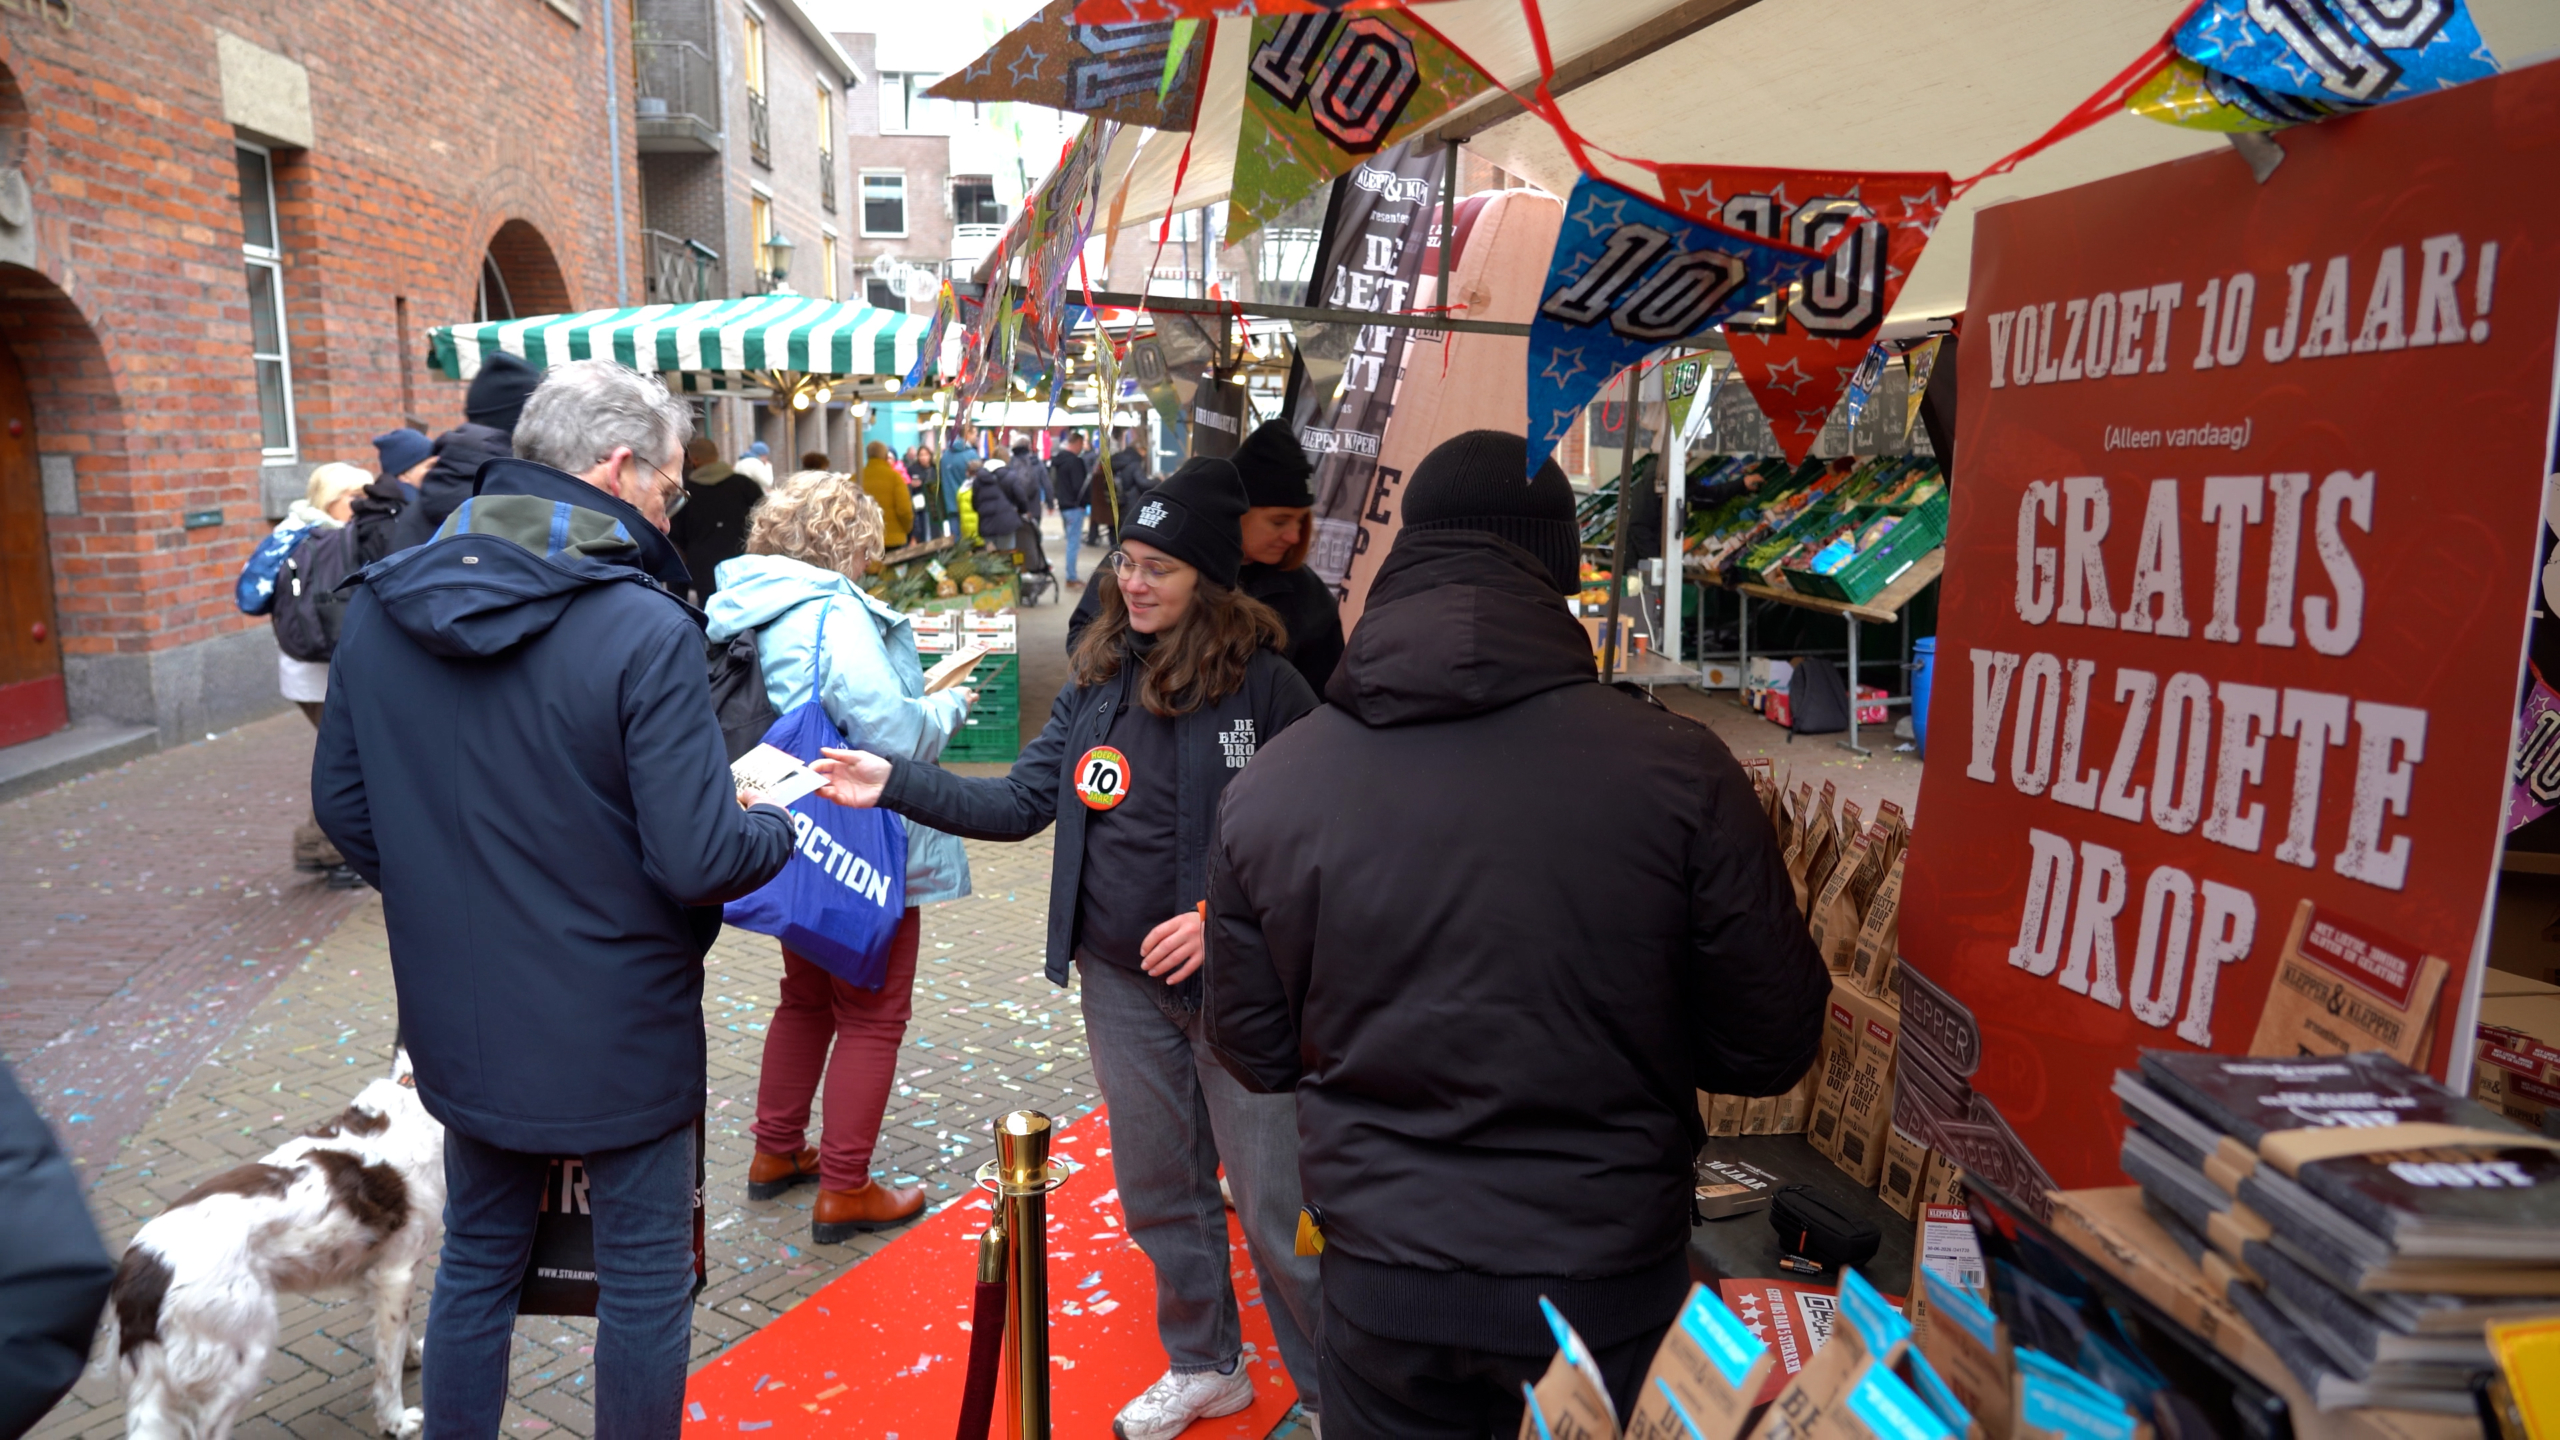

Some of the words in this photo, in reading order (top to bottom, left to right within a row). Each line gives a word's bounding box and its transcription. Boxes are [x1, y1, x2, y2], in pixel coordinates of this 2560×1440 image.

[1250, 12, 1421, 155] 10
[1541, 222, 1747, 344] 10
[1987, 281, 2183, 389] VOLZOET
[2193, 273, 2256, 371] 10
[2262, 234, 2499, 362] JAAR!
[1669, 360, 1700, 400] 10
[2104, 424, 2161, 451] (Alleen
[2165, 418, 2252, 449] vandaag)
[2013, 469, 2376, 657] GRATIS
[1218, 731, 1257, 744] BEST
[1233, 719, 1255, 731] DE
[1091, 750, 1121, 765] HOERA!
[1223, 743, 1255, 756] DRO
[1088, 762, 1118, 794] 10
[1966, 648, 2428, 891] VOLZOETE
[1087, 791, 1115, 806] JAAR!
[794, 811, 892, 909] ACTION
[1873, 894, 1896, 913] BESTE
[1884, 886, 1895, 899] DE
[1866, 917, 1884, 933] OOIT
[1870, 905, 1889, 922] DROP
[2008, 827, 2257, 1049] DROP
[2283, 965, 2331, 1000] KLEPPER
[2326, 983, 2347, 1018] &
[2346, 1003, 2401, 1045] KLEPPER
[1902, 978, 1969, 1064] LEPPER
[1854, 1068, 1881, 1097] BESTE
[1865, 1062, 1878, 1080] DE
[1849, 1095, 1871, 1118] OOIT
[1852, 1083, 1875, 1106] DROP
[1720, 1168, 1768, 1191] JAAR
[1769, 1303, 1787, 1315] ONS
[1778, 1335, 1802, 1375] STERREN
